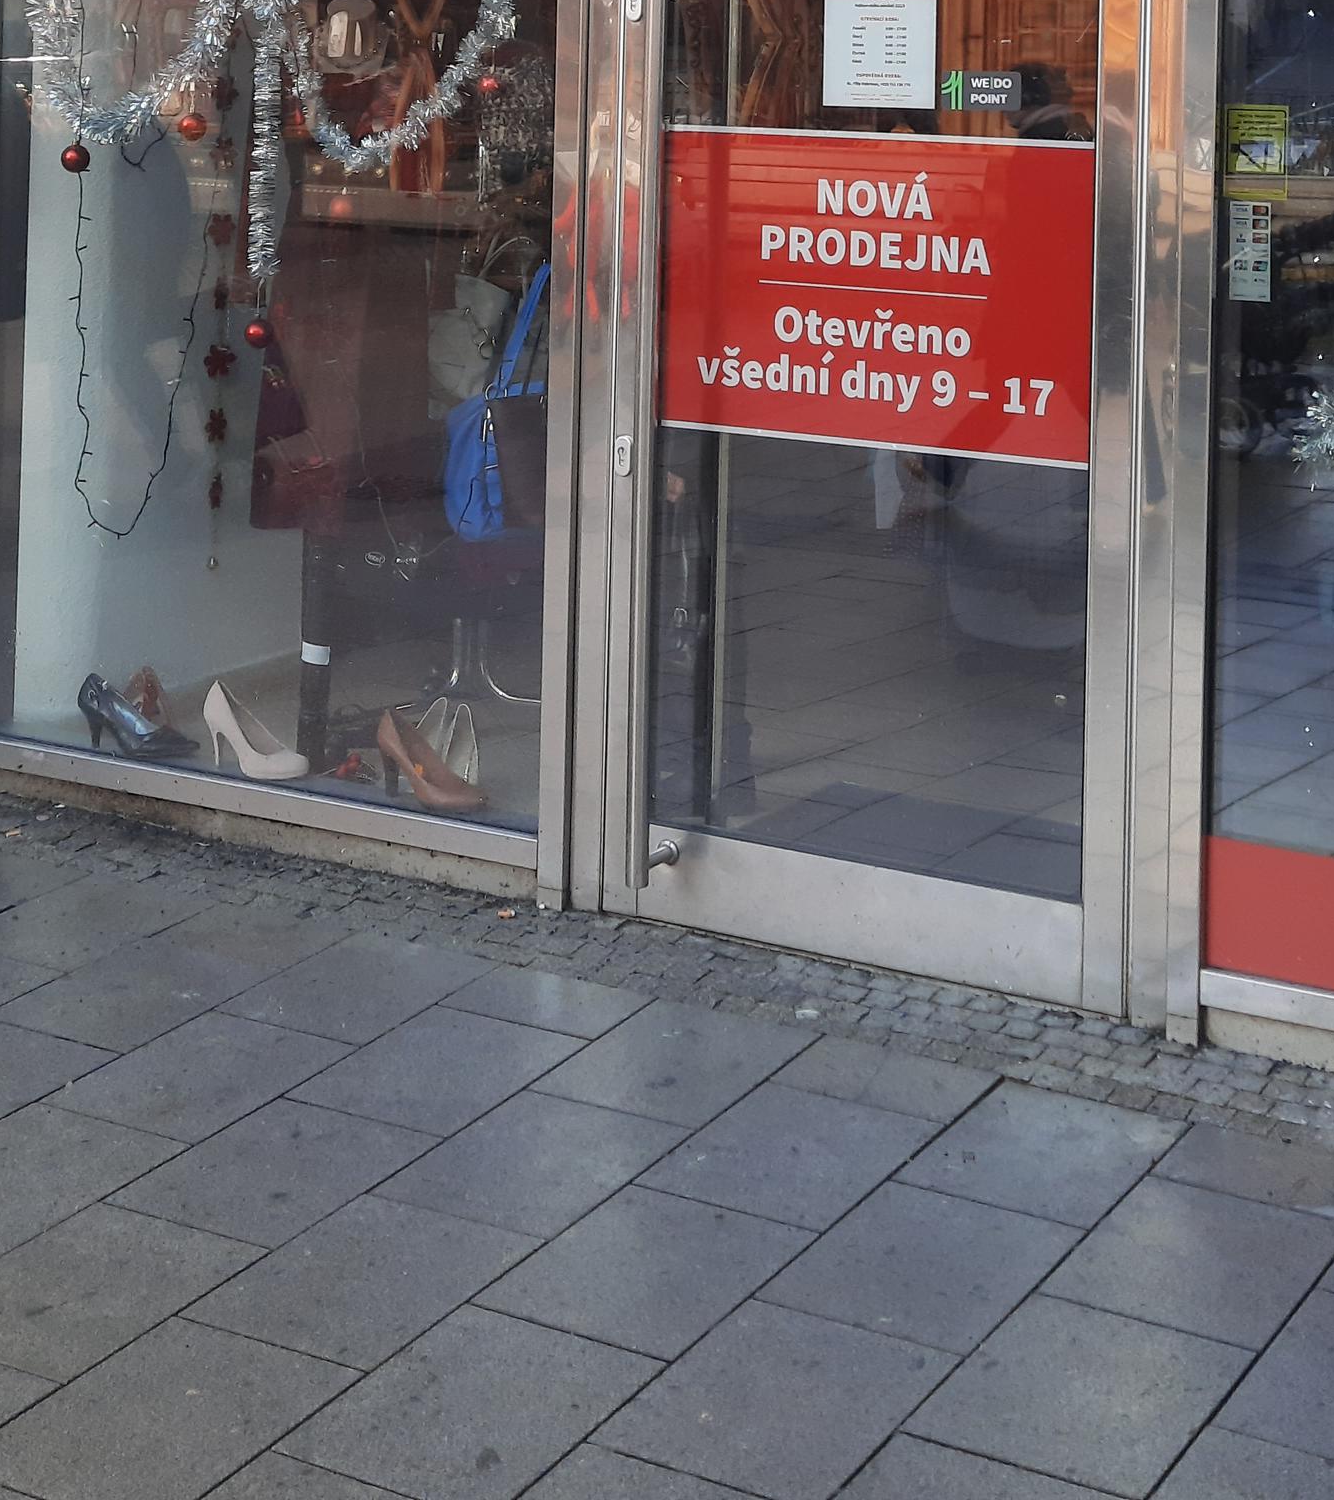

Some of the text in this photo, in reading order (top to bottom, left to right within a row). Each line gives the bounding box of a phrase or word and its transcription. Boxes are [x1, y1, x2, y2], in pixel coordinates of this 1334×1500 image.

[970, 93, 1008, 104] POINT
[816, 171, 934, 221] NOVÁ
[760, 223, 992, 276] PRODEJNA
[773, 304, 972, 358] Otevřeno
[696, 346, 835, 396] všední
[840, 360, 922, 415] dny
[931, 371, 957, 408] 9
[1002, 376, 1055, 417] 17
